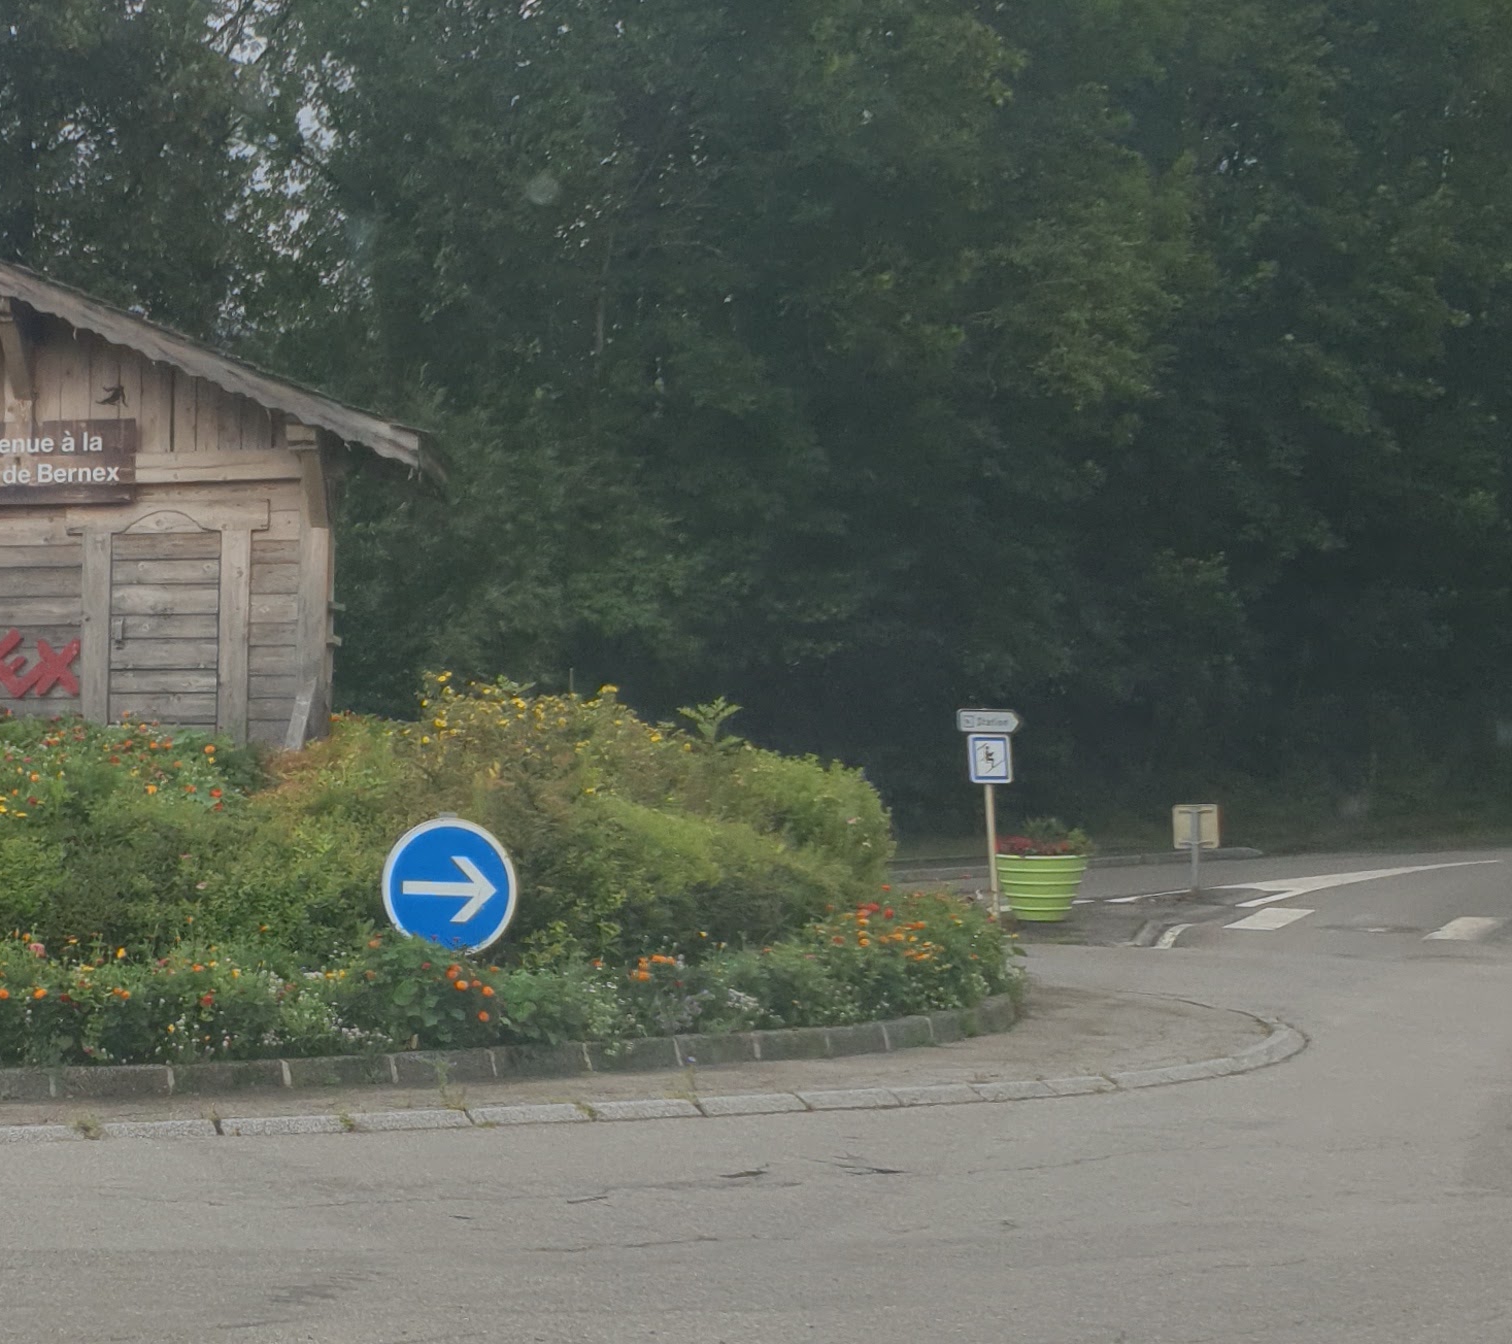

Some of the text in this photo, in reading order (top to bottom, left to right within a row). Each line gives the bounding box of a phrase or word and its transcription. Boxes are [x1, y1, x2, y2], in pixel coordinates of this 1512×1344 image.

[61, 430, 76, 453] à
[82, 432, 103, 452] la
[2, 465, 31, 484] de
[37, 463, 120, 484] Bernex
